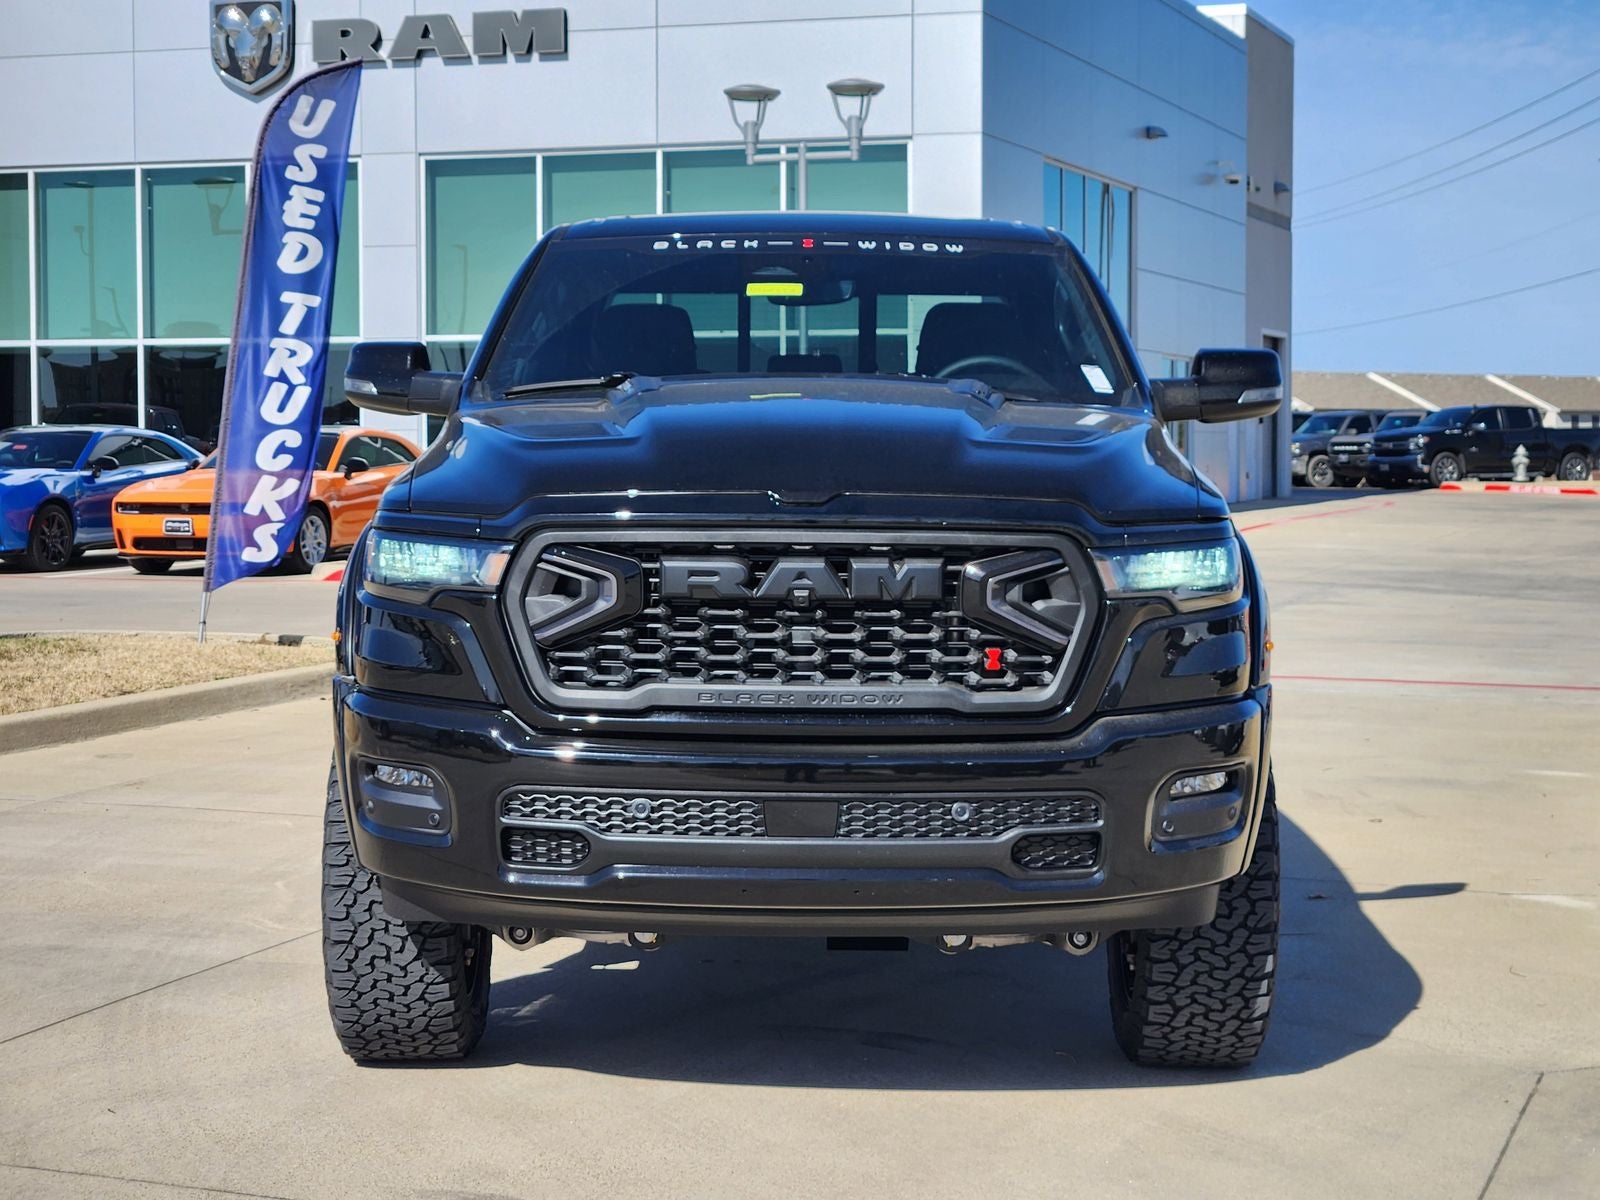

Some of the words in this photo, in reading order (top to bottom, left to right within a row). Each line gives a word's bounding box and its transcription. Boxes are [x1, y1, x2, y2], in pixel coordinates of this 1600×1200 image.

[311, 8, 567, 64] RAM
[276, 94, 337, 275] USED
[652, 239, 759, 250] BLACK
[857, 240, 964, 254] WIDOW
[240, 290, 322, 563] TRUCKS
[660, 555, 944, 600] RAM
[698, 692, 795, 705] BLACK
[806, 693, 904, 705] WIDOW
